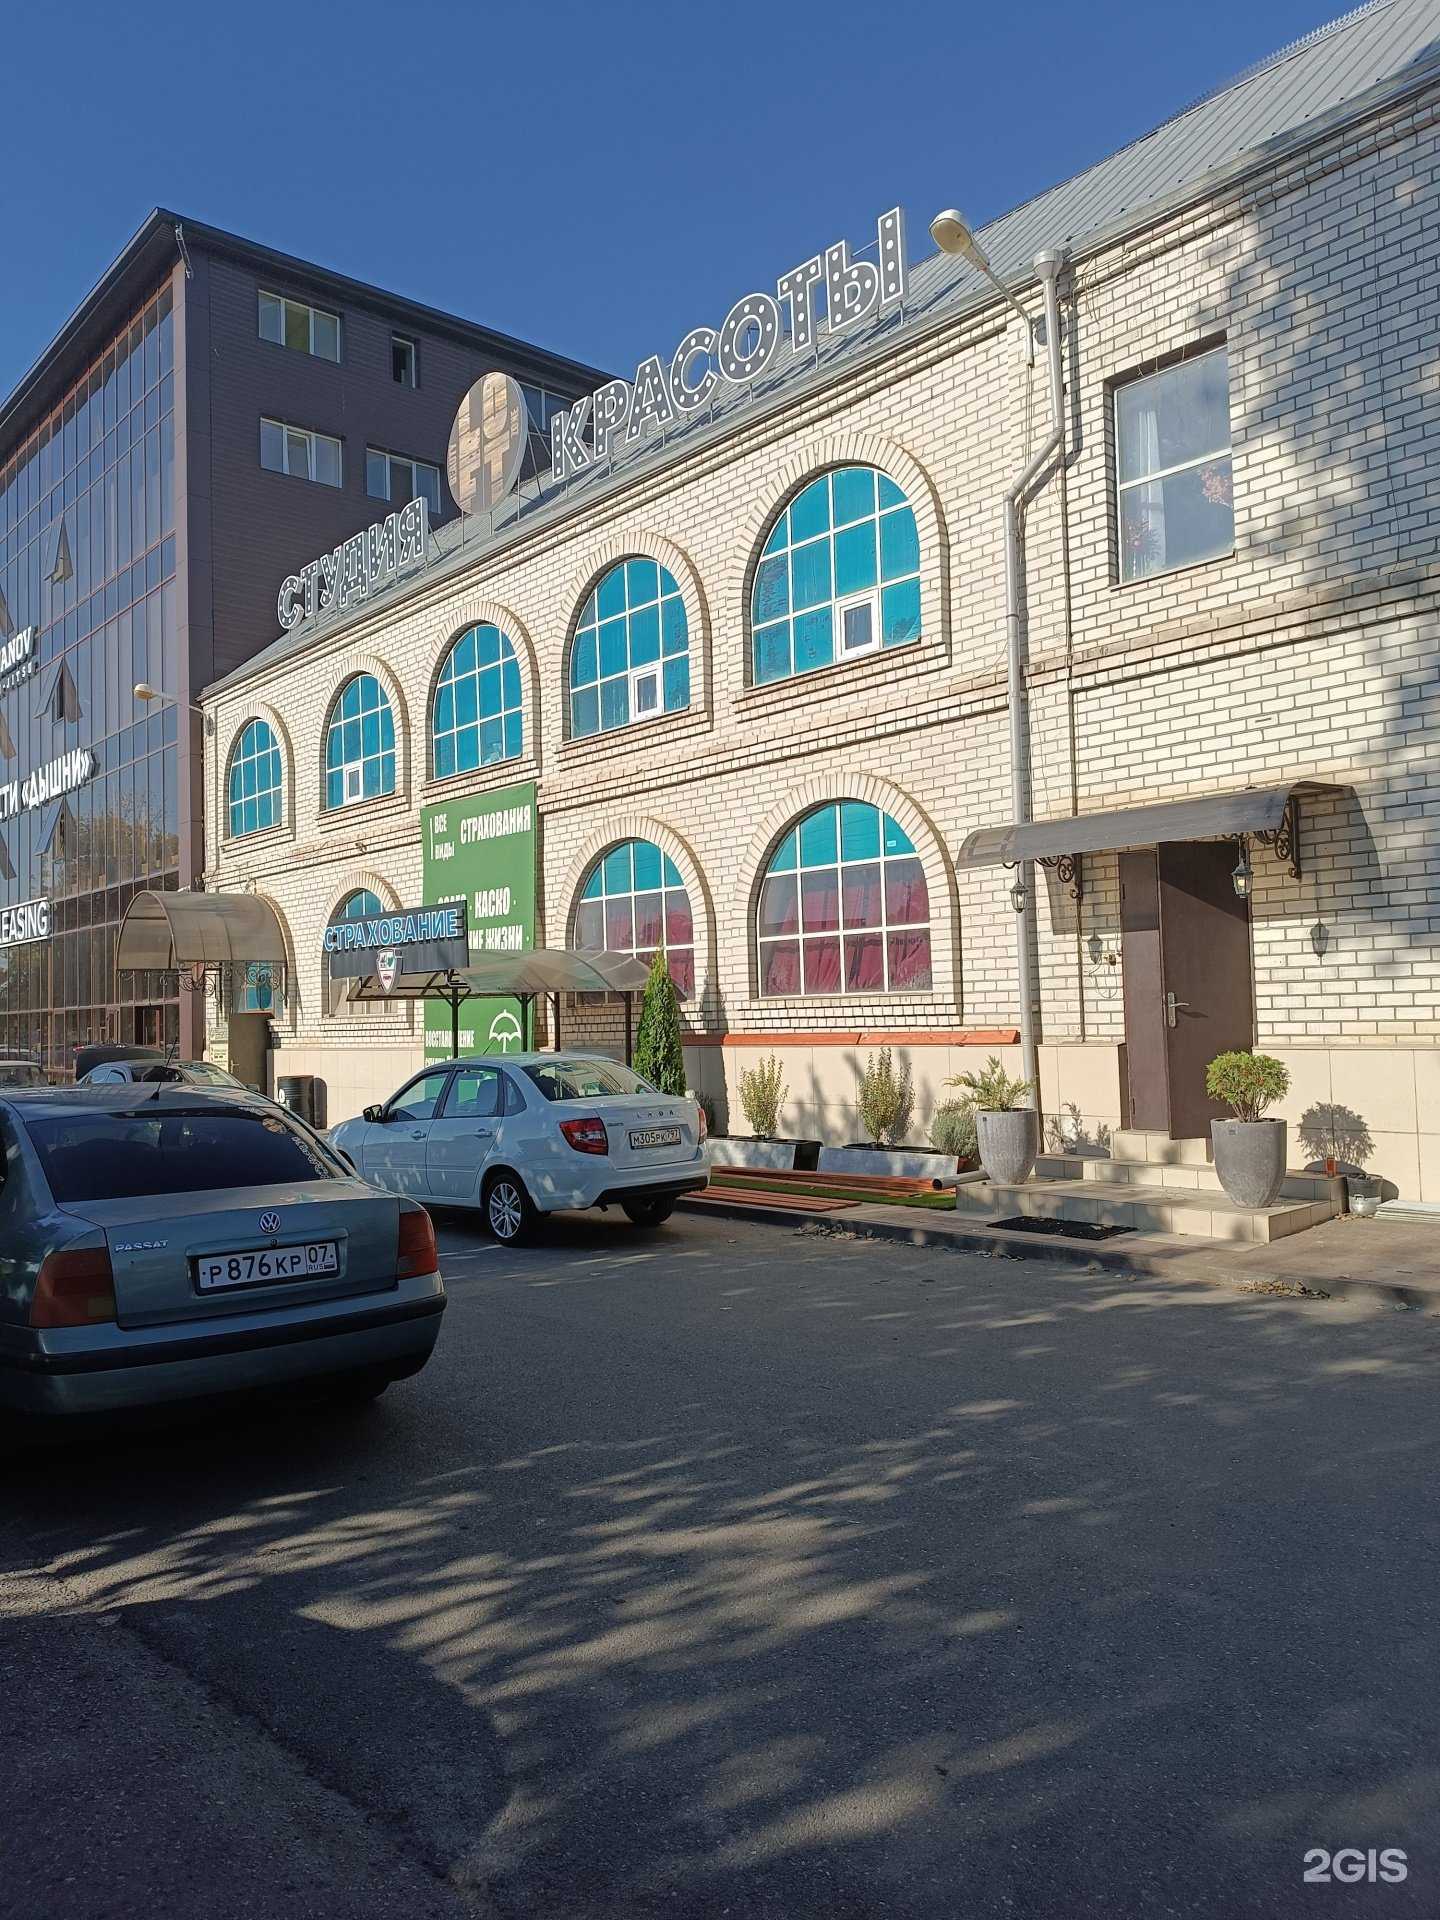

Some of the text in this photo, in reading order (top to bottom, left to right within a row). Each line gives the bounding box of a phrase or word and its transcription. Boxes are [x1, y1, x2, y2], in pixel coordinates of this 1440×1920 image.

[276, 206, 906, 631] СТУДИЯ КРАСОТЫ
[0, 747, 90, 820] ТИ «ДЫШНИ»
[434, 813, 448, 834] ВСЕ
[460, 805, 531, 845] СТРАХОВАНИЯ
[474, 886, 511, 919] КАСКО
[0, 901, 48, 943] EASING
[324, 908, 458, 951] СТРАХОВАНИЕ
[485, 924, 523, 950] ЖИЗНИ
[115, 1239, 169, 1252] PASSAT
[308, 1245, 329, 1264] 07
[308, 1263, 324, 1272] RUS
